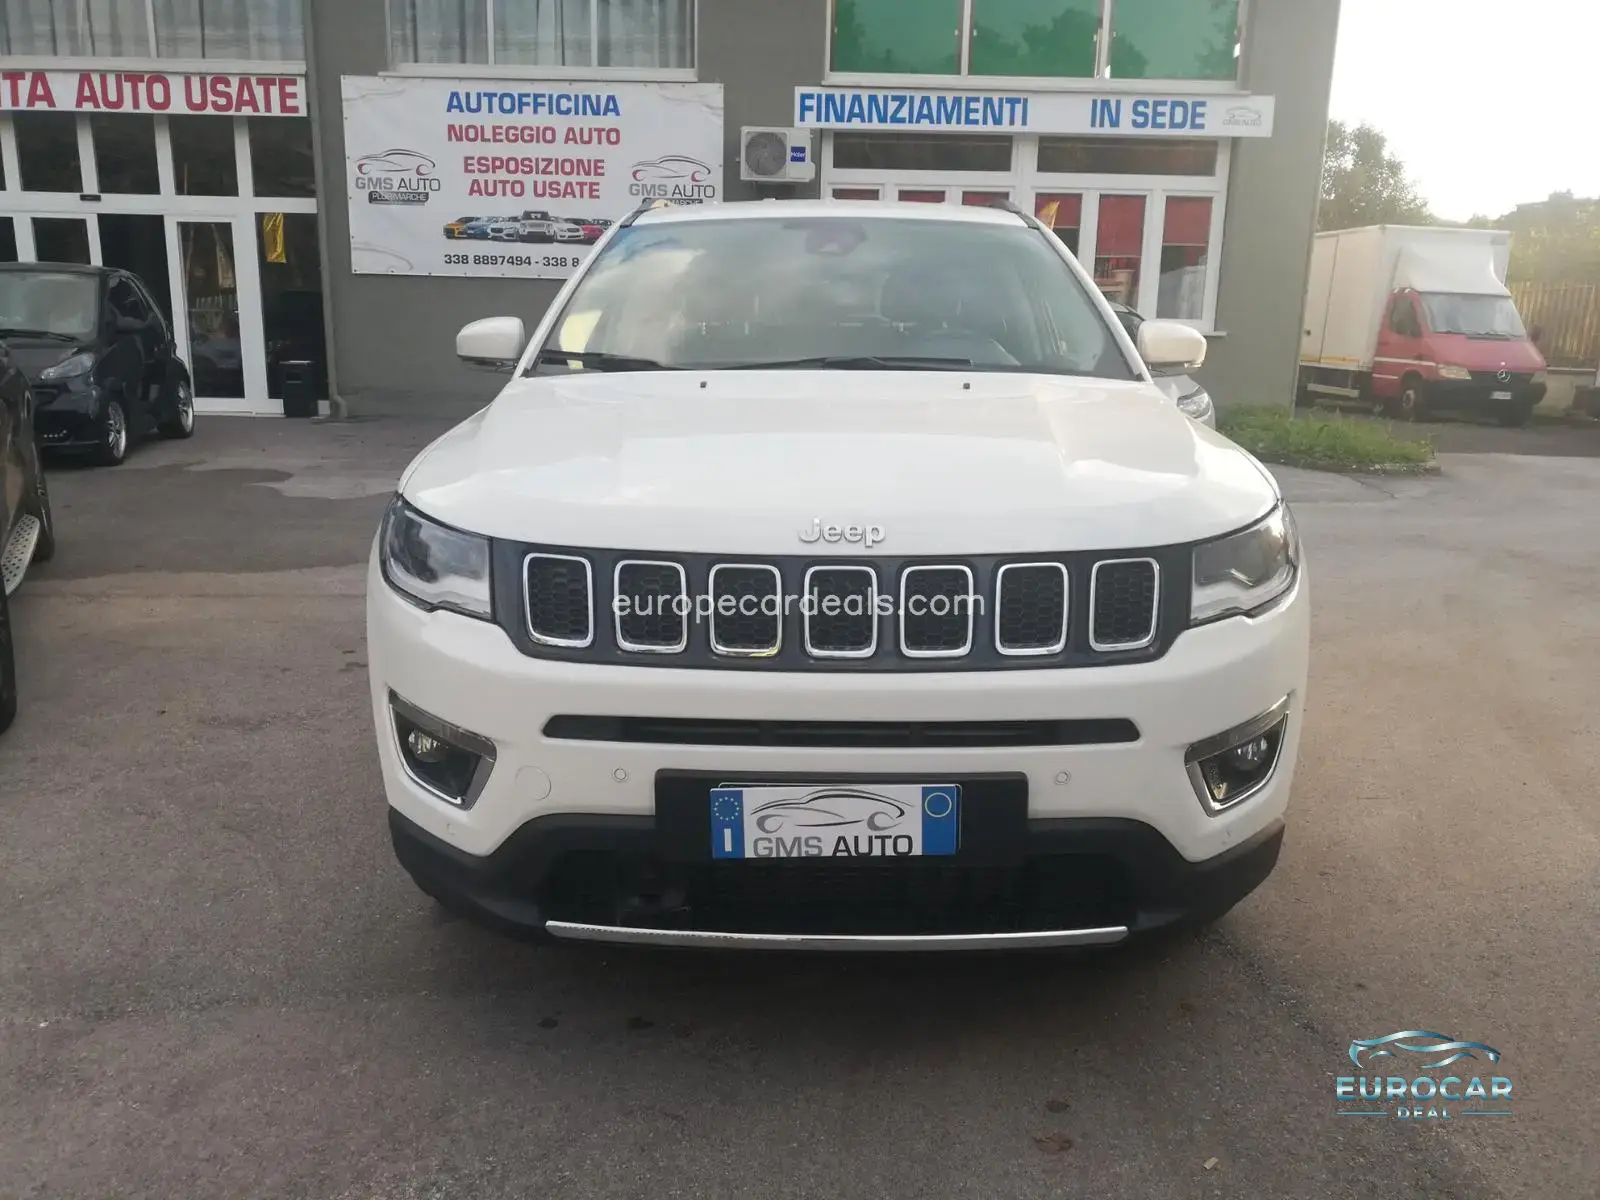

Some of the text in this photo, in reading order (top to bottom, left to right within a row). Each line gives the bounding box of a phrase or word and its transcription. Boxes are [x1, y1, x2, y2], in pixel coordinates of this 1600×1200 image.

[0, 71, 300, 114] TA AUTO USATE
[446, 91, 621, 117] AUTOFFICINA
[800, 93, 1207, 130] FINANZIAMENTI IN SEDE
[447, 124, 621, 146] NOLEGGIO AUTO
[463, 156, 606, 177] ESPOSIZIONE
[355, 176, 441, 192] GMS AUTO
[468, 179, 600, 199] AUTO USATE
[628, 183, 716, 199] GMS AUTO
[444, 254, 469, 265] 338
[473, 255, 532, 266] 8897494
[542, 257, 567, 267] 338
[571, 257, 580, 268] 8
[799, 517, 887, 548] Jeep
[753, 835, 914, 857] GMS AUTO
